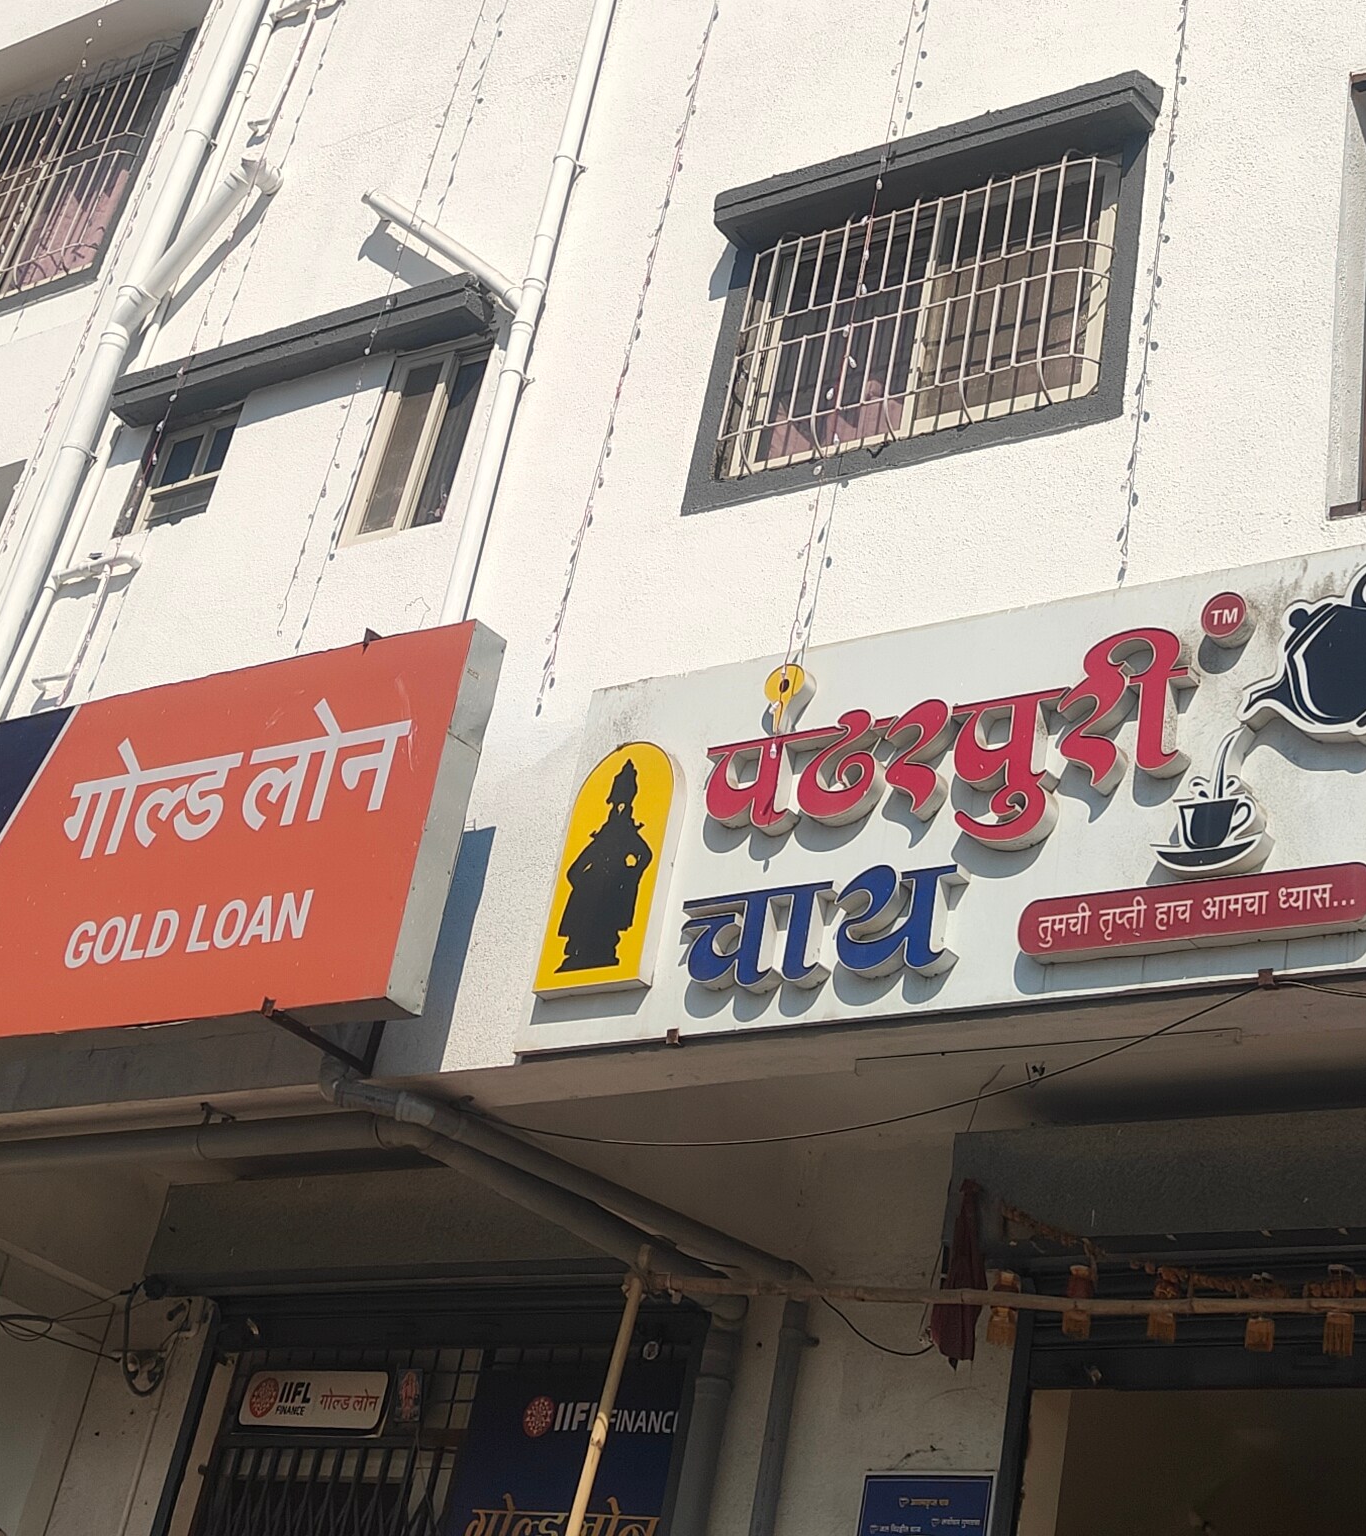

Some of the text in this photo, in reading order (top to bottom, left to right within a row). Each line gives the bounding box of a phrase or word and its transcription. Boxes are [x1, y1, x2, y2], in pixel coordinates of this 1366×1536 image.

[1209, 607, 1239, 627] TM
[706, 627, 1191, 852] पंढरपुरी
[63, 697, 411, 860] गोल्ड लोन
[63, 887, 315, 970] GOLD LOAN
[683, 864, 959, 987] चाय
[1037, 902, 1092, 948] तुमची
[1154, 899, 1194, 931] हाच
[1201, 890, 1270, 921] आमचा
[275, 1404, 306, 1416] FINANCE
[278, 1381, 312, 1404] IIFL
[319, 1388, 381, 1412] गोल्ड लोन
